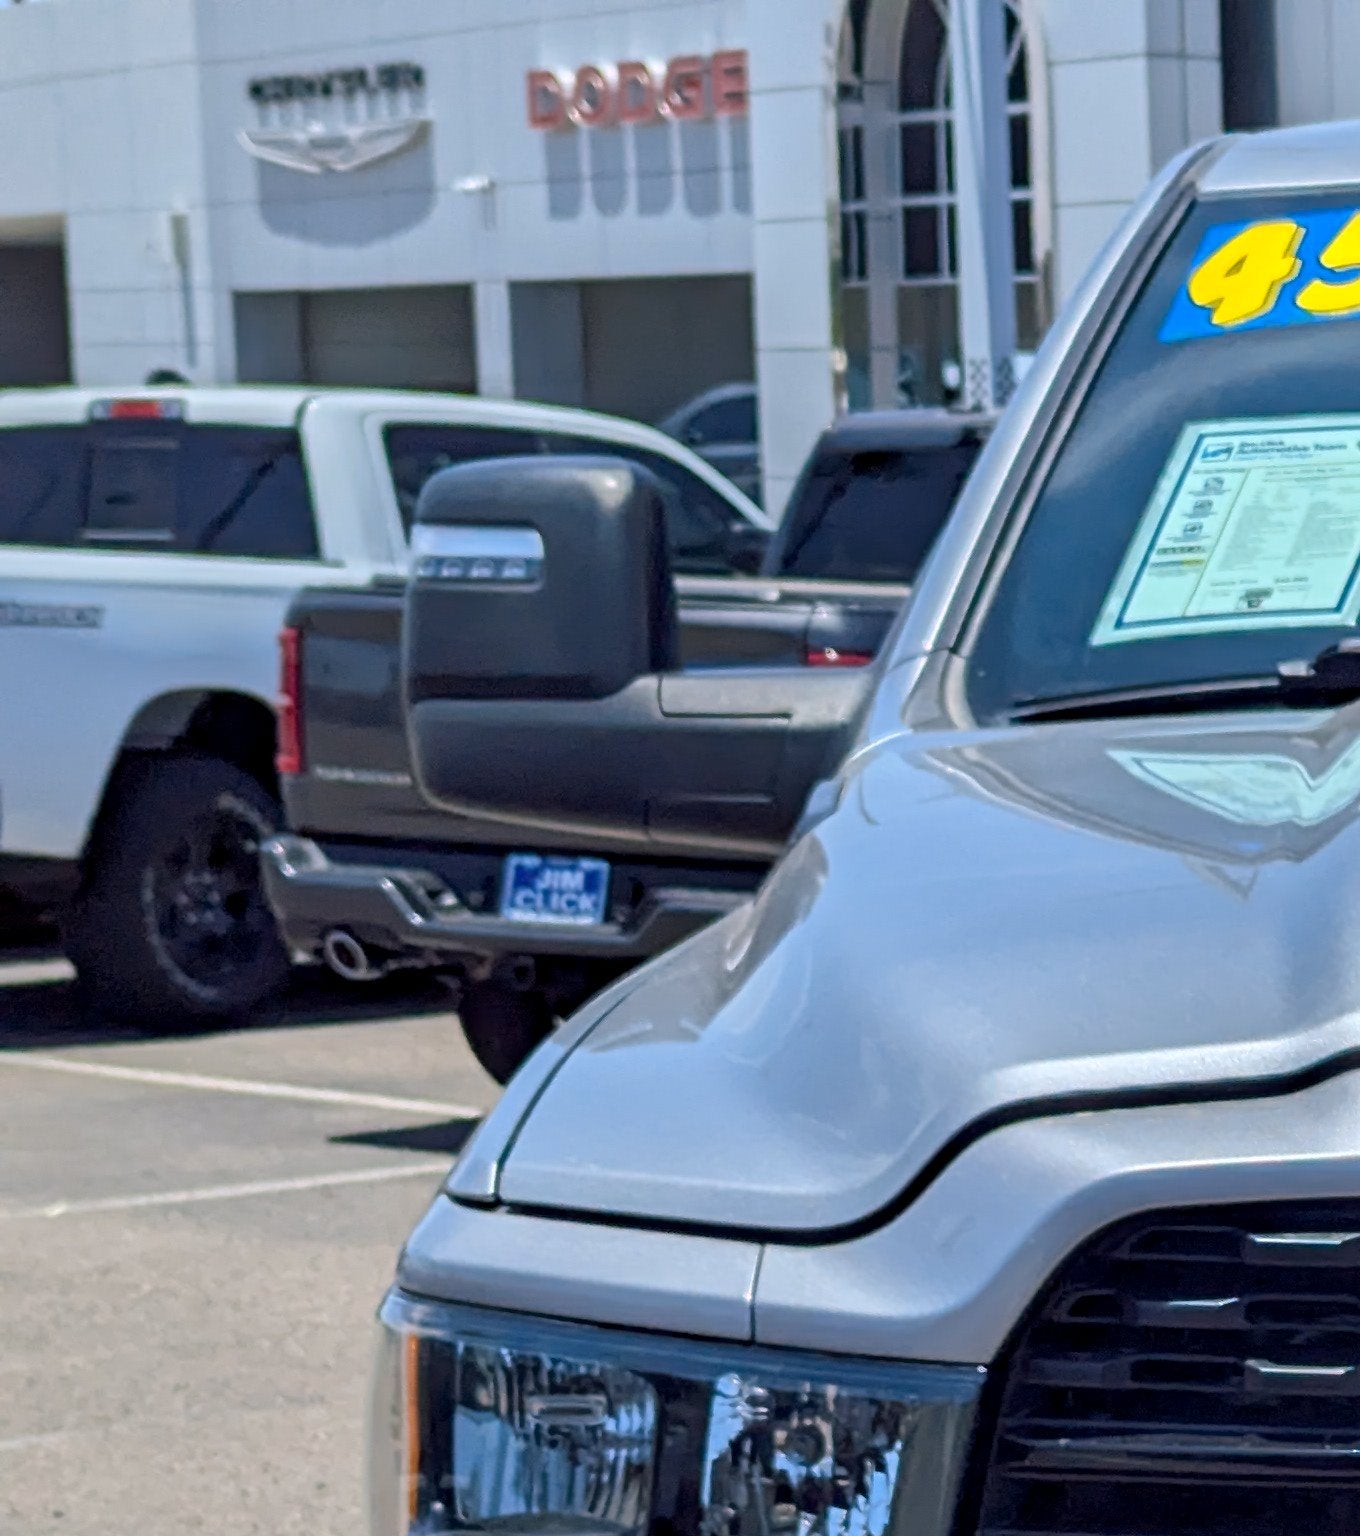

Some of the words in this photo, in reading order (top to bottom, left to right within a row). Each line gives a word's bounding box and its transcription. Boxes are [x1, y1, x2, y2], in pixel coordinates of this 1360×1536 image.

[526, 48, 748, 130] DODGE
[535, 868, 585, 891] JIM
[514, 888, 598, 914] CLICK
